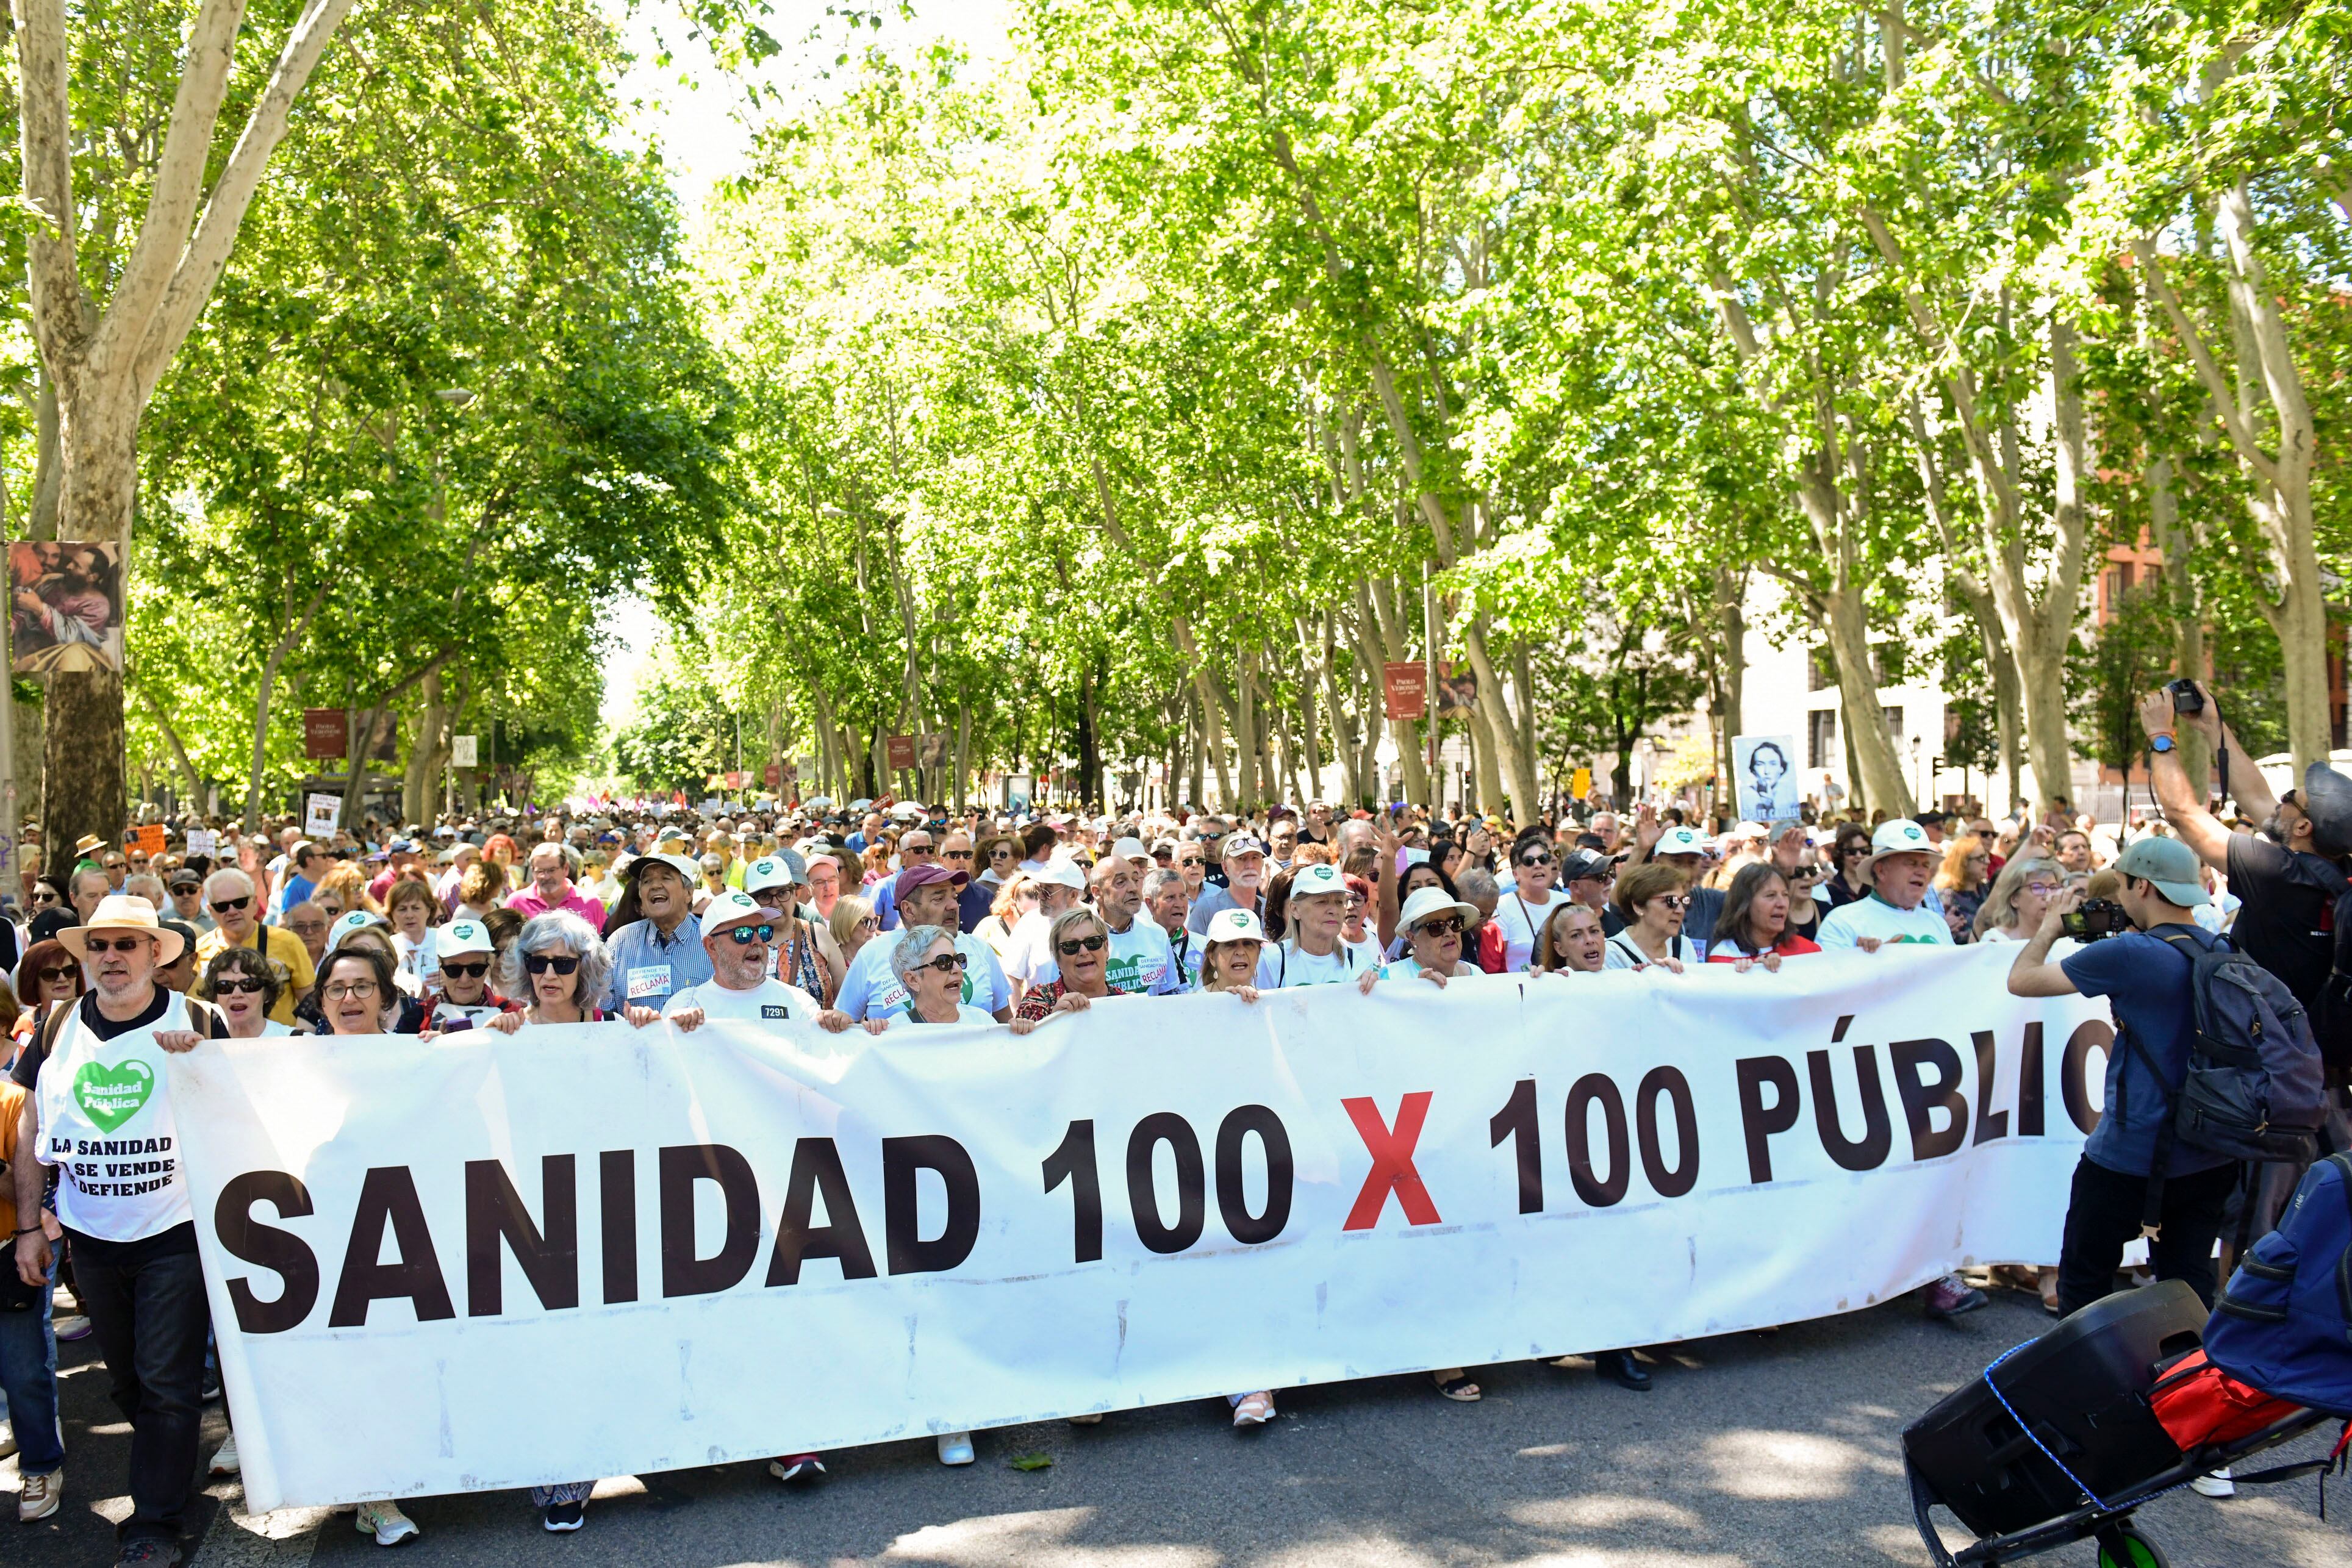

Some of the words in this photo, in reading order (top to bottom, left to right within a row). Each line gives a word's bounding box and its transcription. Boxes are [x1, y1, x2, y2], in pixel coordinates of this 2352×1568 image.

[882, 977, 896, 986] DEFIE
[1105, 966, 1139, 981] SANIDA
[630, 976, 669, 996] RECLAMA
[1109, 978, 1142, 990] ÚBLIC
[884, 986, 907, 1006] RECLA
[765, 1008, 784, 1017] 7291
[82, 1081, 142, 1095] Sanidad
[84, 1096, 140, 1109] Pública
[51, 1138, 71, 1153] LA
[77, 1137, 172, 1156] SANIDAD
[74, 1163, 98, 1177] SE
[106, 1159, 175, 1177] VENDE
[214, 1134, 980, 1334] SANIDAD
[1042, 1104, 1294, 1264] 100
[1341, 1090, 1442, 1231] X
[1490, 1065, 1700, 1215] 100
[1735, 1015, 2117, 1184] PÚBLIC
[79, 1174, 173, 1197] DEFIENDE
